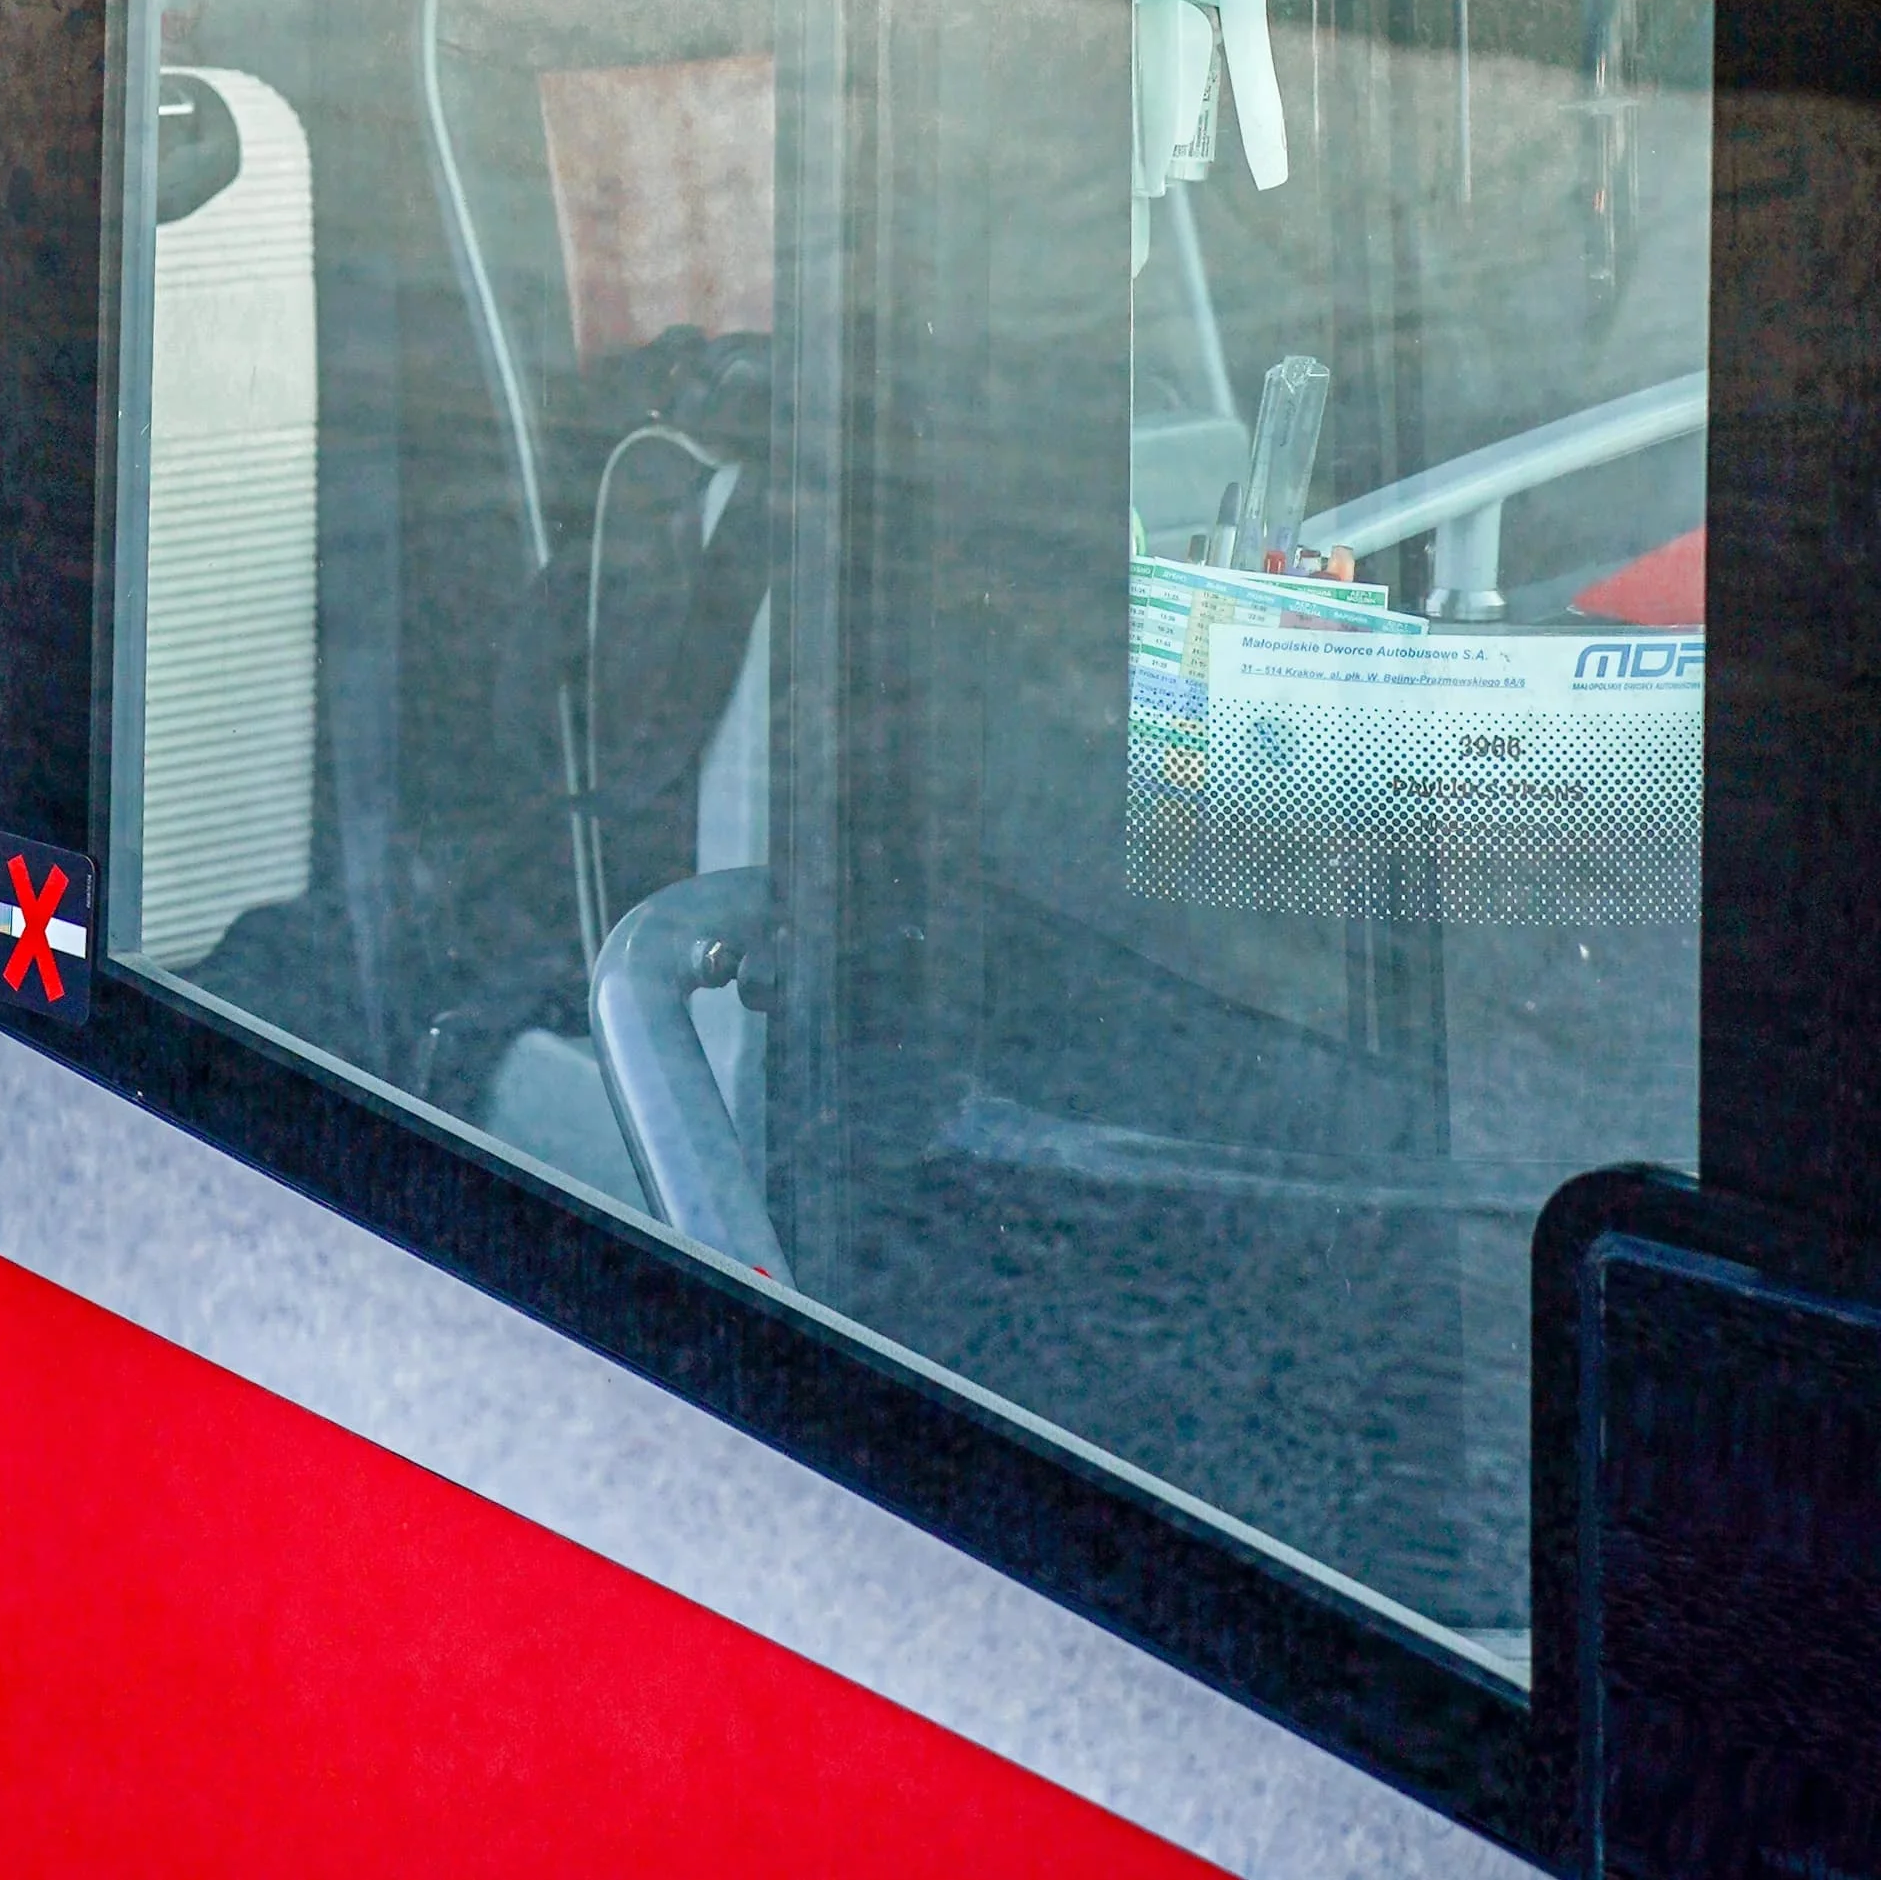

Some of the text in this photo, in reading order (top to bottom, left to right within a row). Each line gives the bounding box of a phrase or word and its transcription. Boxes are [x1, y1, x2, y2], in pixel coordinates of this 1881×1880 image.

[1323, 642, 1374, 657] Dworce
[1376, 645, 1459, 660] Autobusowe
[1462, 649, 1489, 661] S.A.
[1240, 663, 1253, 674] 31
[1264, 665, 1283, 676] 514
